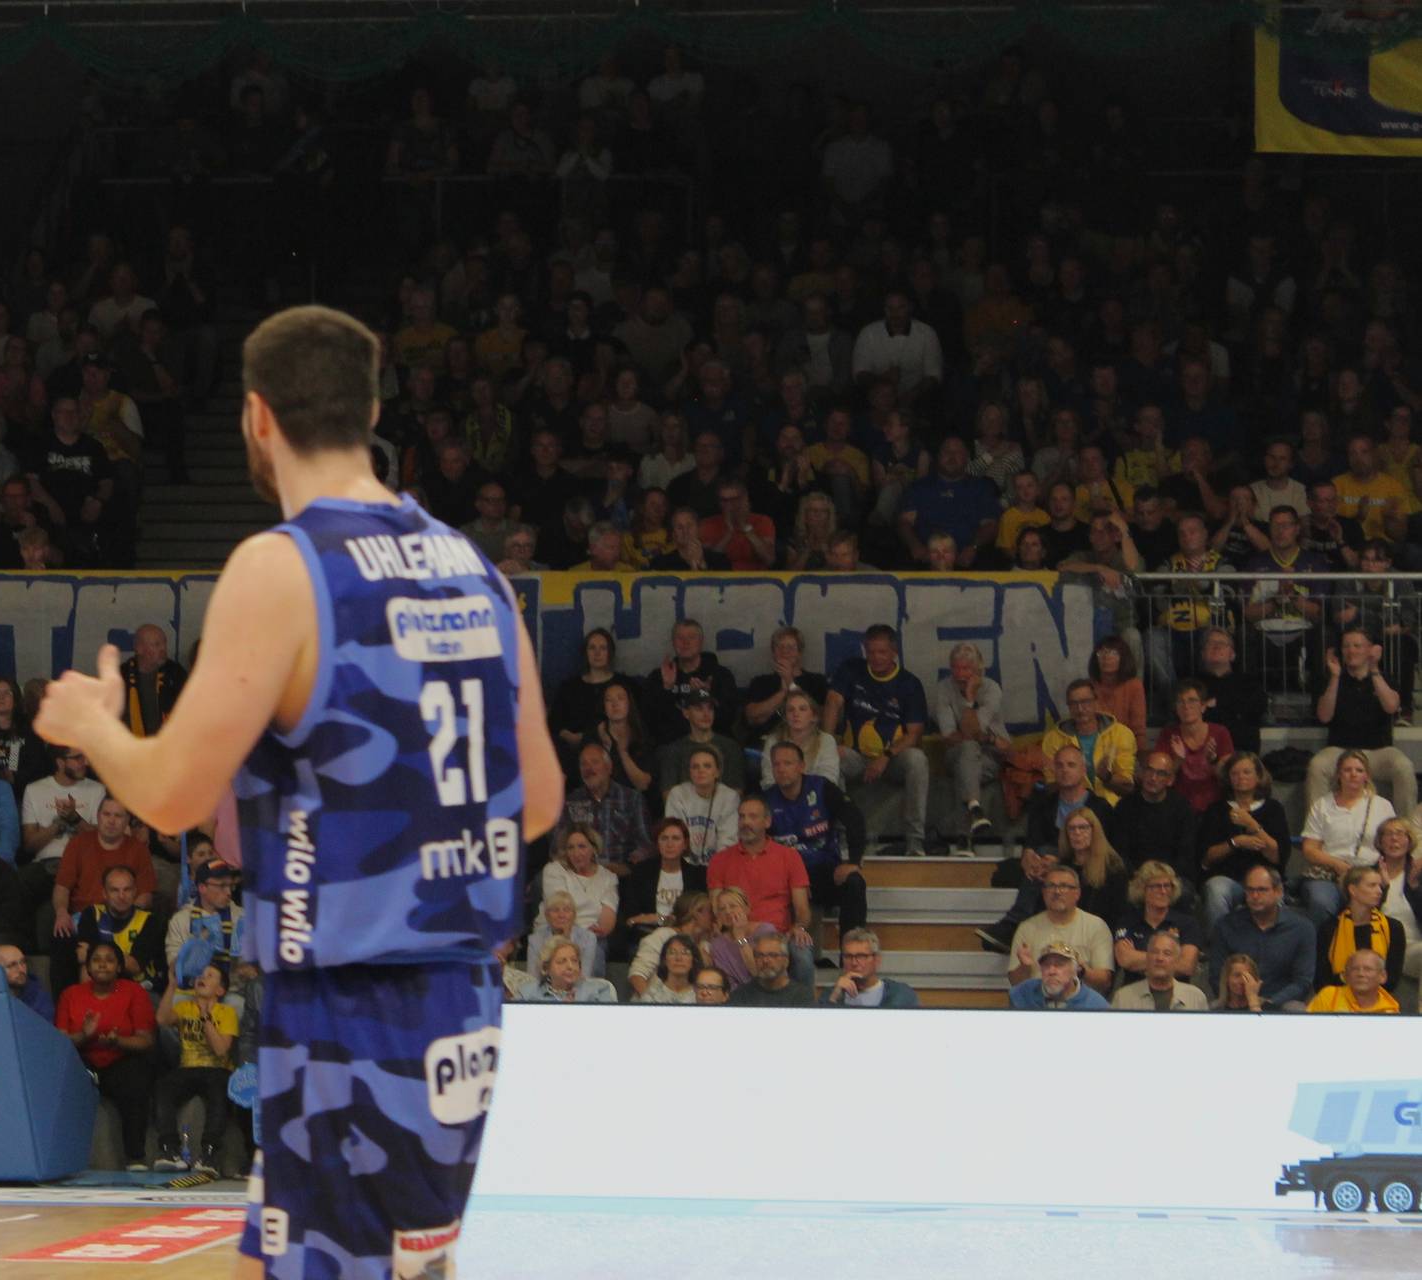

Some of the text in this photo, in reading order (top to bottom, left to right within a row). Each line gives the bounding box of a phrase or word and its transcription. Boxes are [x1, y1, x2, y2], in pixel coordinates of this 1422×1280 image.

[346, 534, 488, 581] UHLEMANN
[419, 679, 489, 807] 21
[284, 810, 317, 885] wilo
[280, 889, 314, 965] wilo
